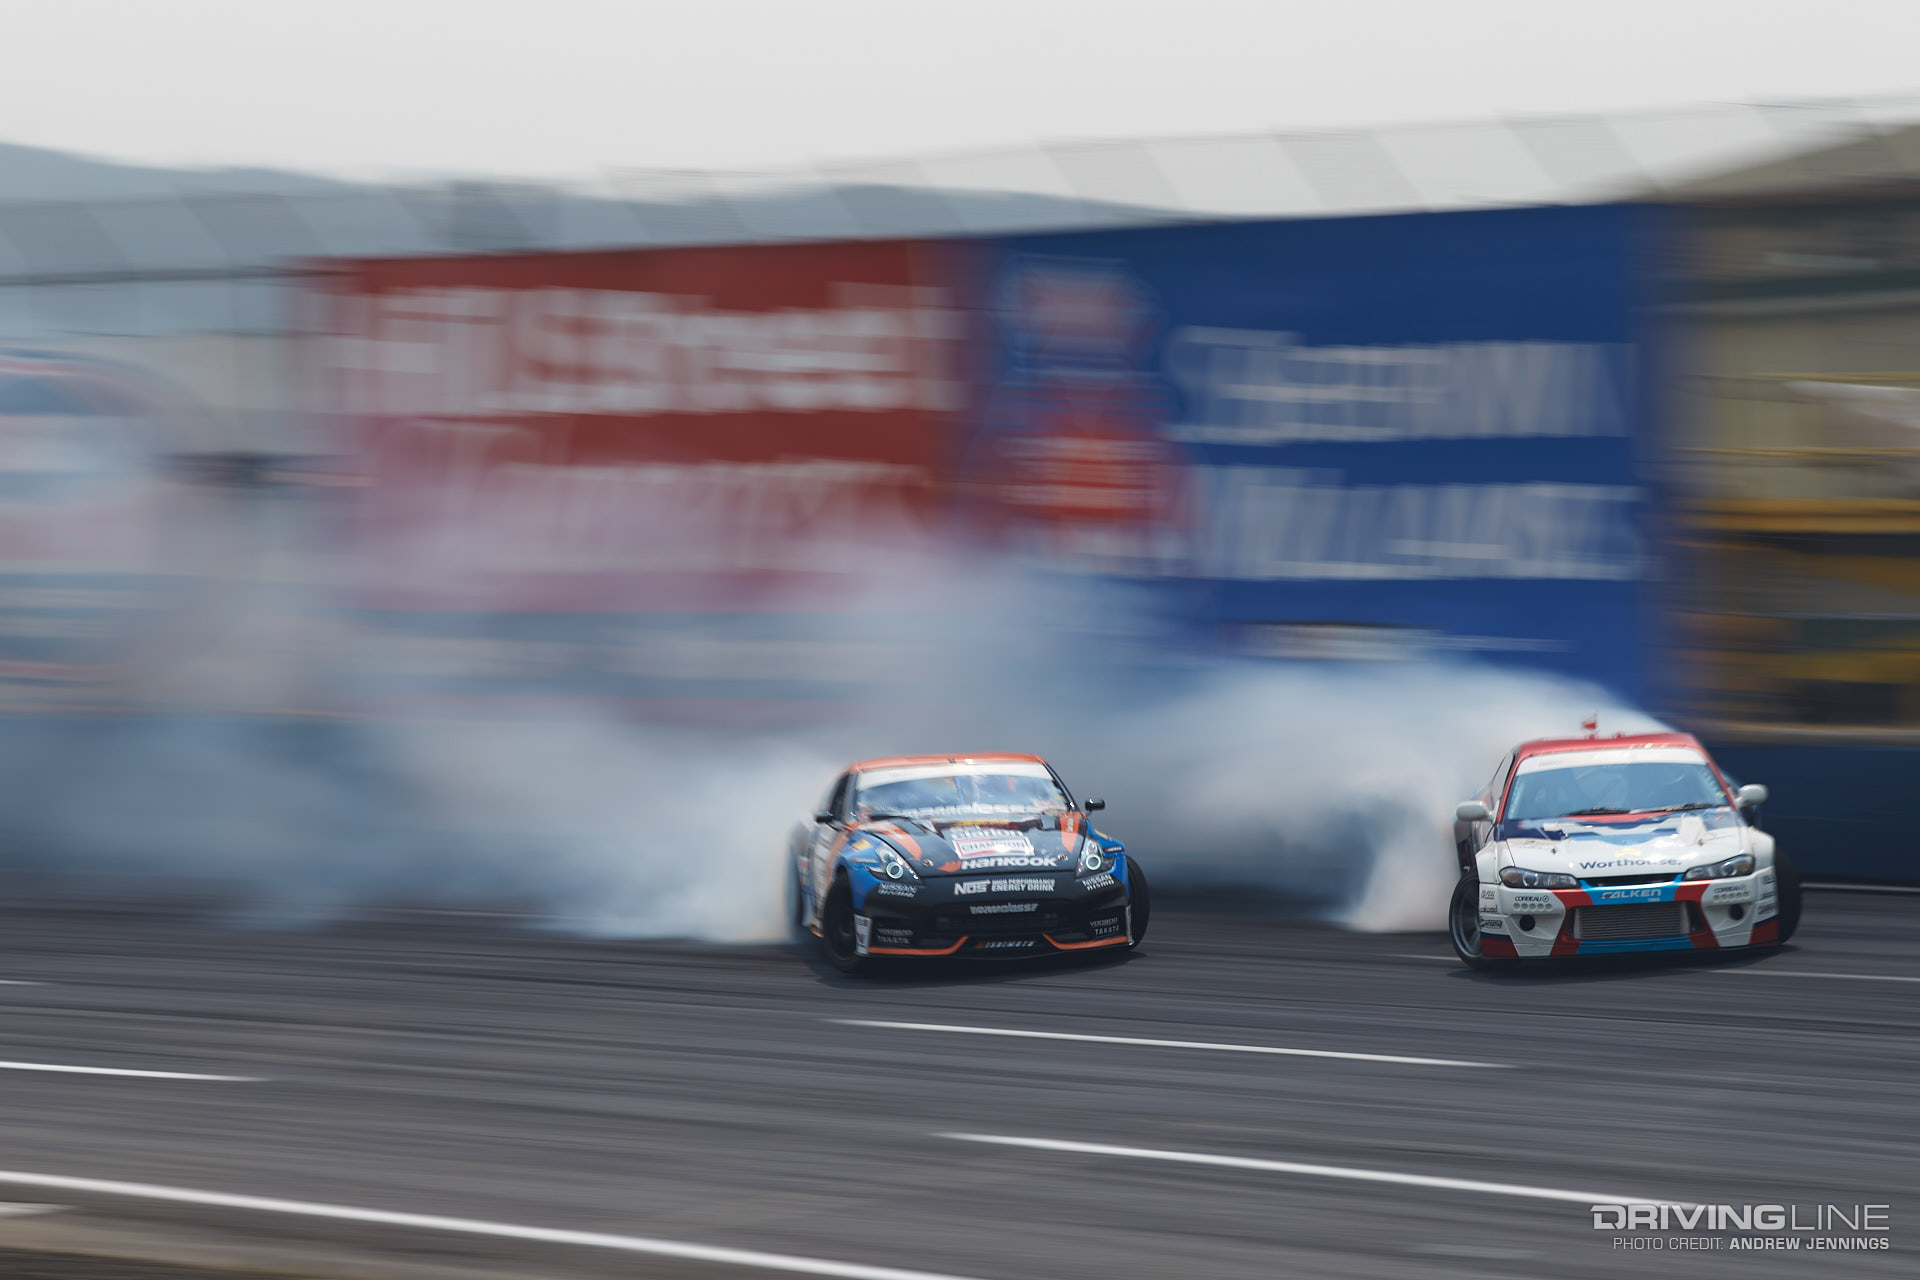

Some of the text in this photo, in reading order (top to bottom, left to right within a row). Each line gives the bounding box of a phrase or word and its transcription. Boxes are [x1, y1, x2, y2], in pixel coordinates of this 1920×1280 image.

[1081, 873, 1112, 887] NISSAN
[991, 883, 1055, 892] ENERGY DRINK
[1095, 925, 1120, 936] TAKATA
